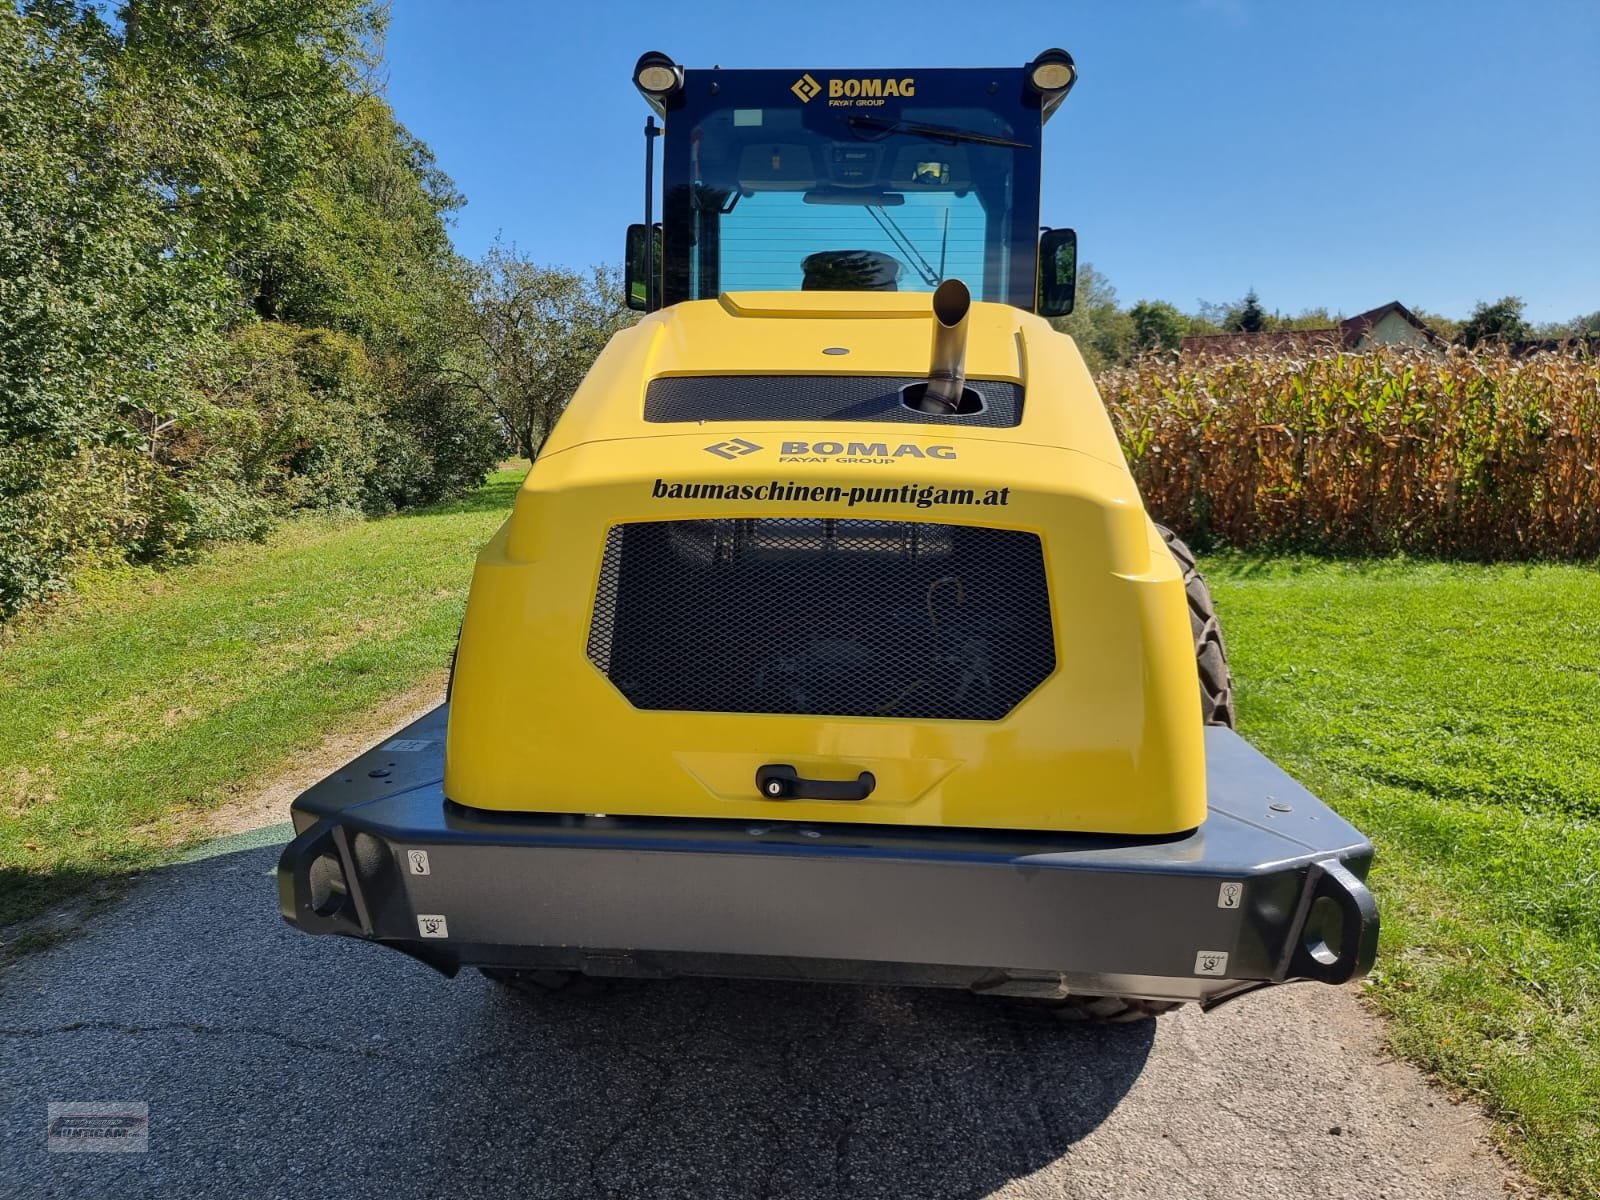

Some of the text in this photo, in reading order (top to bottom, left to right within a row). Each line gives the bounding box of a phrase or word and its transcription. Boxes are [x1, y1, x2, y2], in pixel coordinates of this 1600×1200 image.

[829, 79, 915, 97] BOMAG
[780, 441, 957, 460] BOMAG
[652, 478, 1010, 508] baumaschinen-puntigam.at
